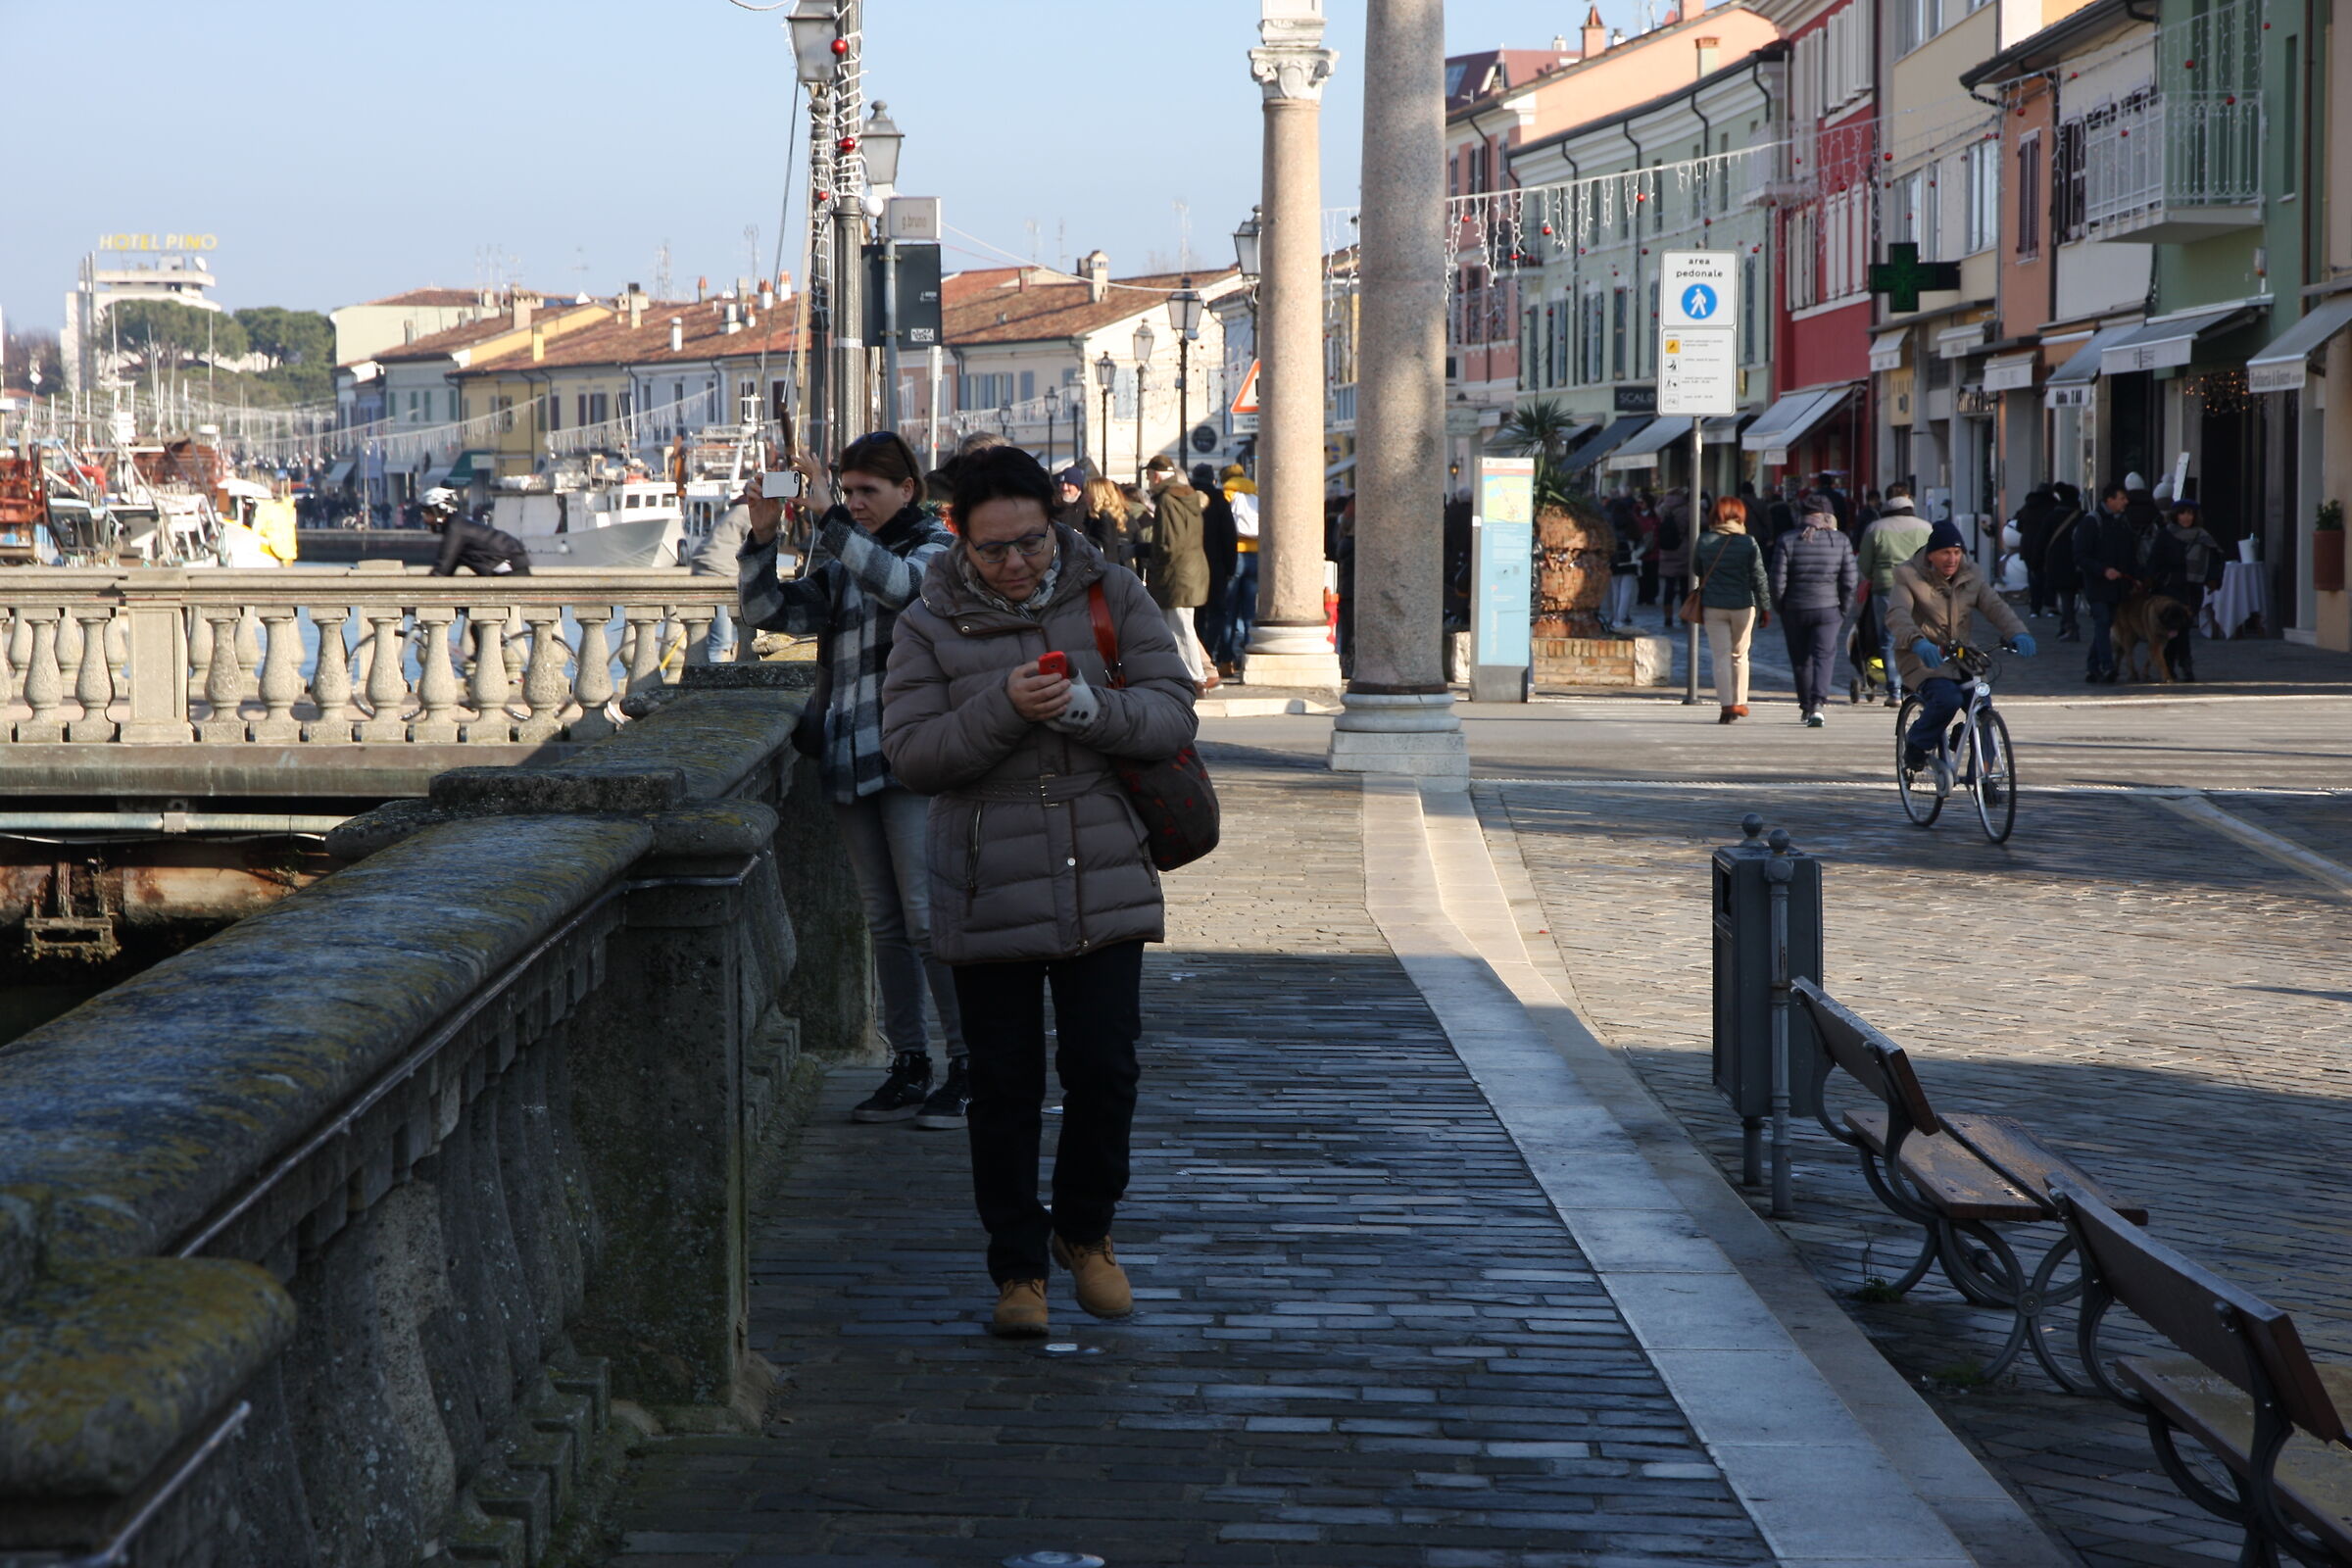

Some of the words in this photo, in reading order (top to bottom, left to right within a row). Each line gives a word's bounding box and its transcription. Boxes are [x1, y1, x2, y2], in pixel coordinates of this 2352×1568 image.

[99, 233, 160, 251] HOTEL
[165, 233, 218, 251] PINO
[1676, 269, 1724, 278] pedonale
